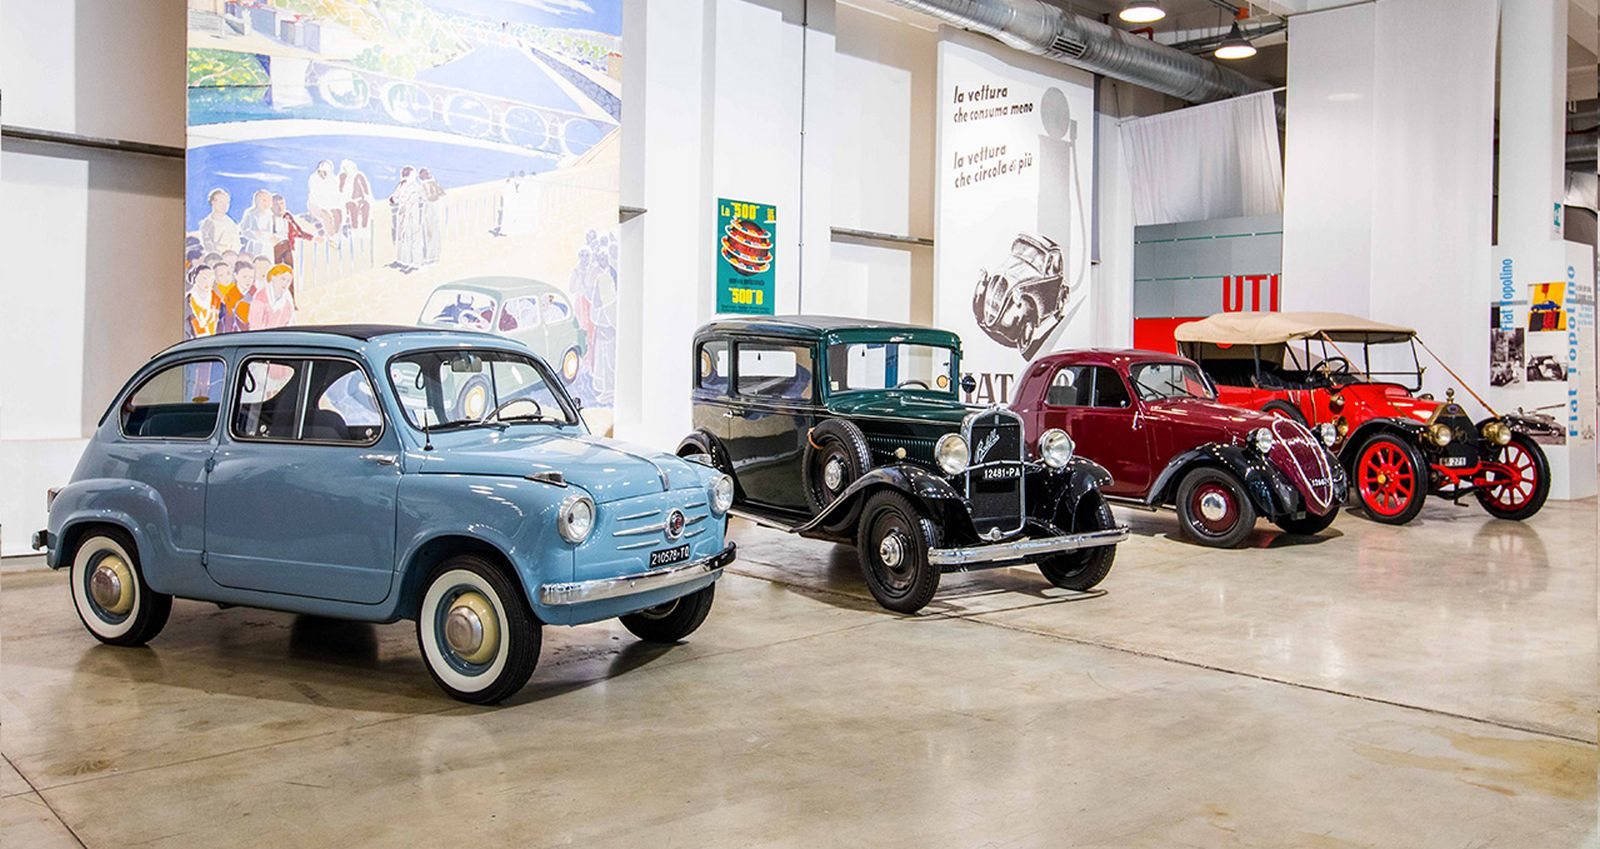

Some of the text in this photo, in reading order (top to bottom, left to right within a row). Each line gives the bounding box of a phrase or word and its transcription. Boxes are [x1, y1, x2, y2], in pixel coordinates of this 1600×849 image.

[953, 85, 1008, 104] la vettura
[953, 102, 1034, 123] che consuma meno
[953, 145, 1007, 169] la vettura
[954, 172, 972, 189] che
[974, 160, 1007, 183] circola
[1222, 274, 1278, 313] UTI
[1500, 258, 1516, 306] Topolino
